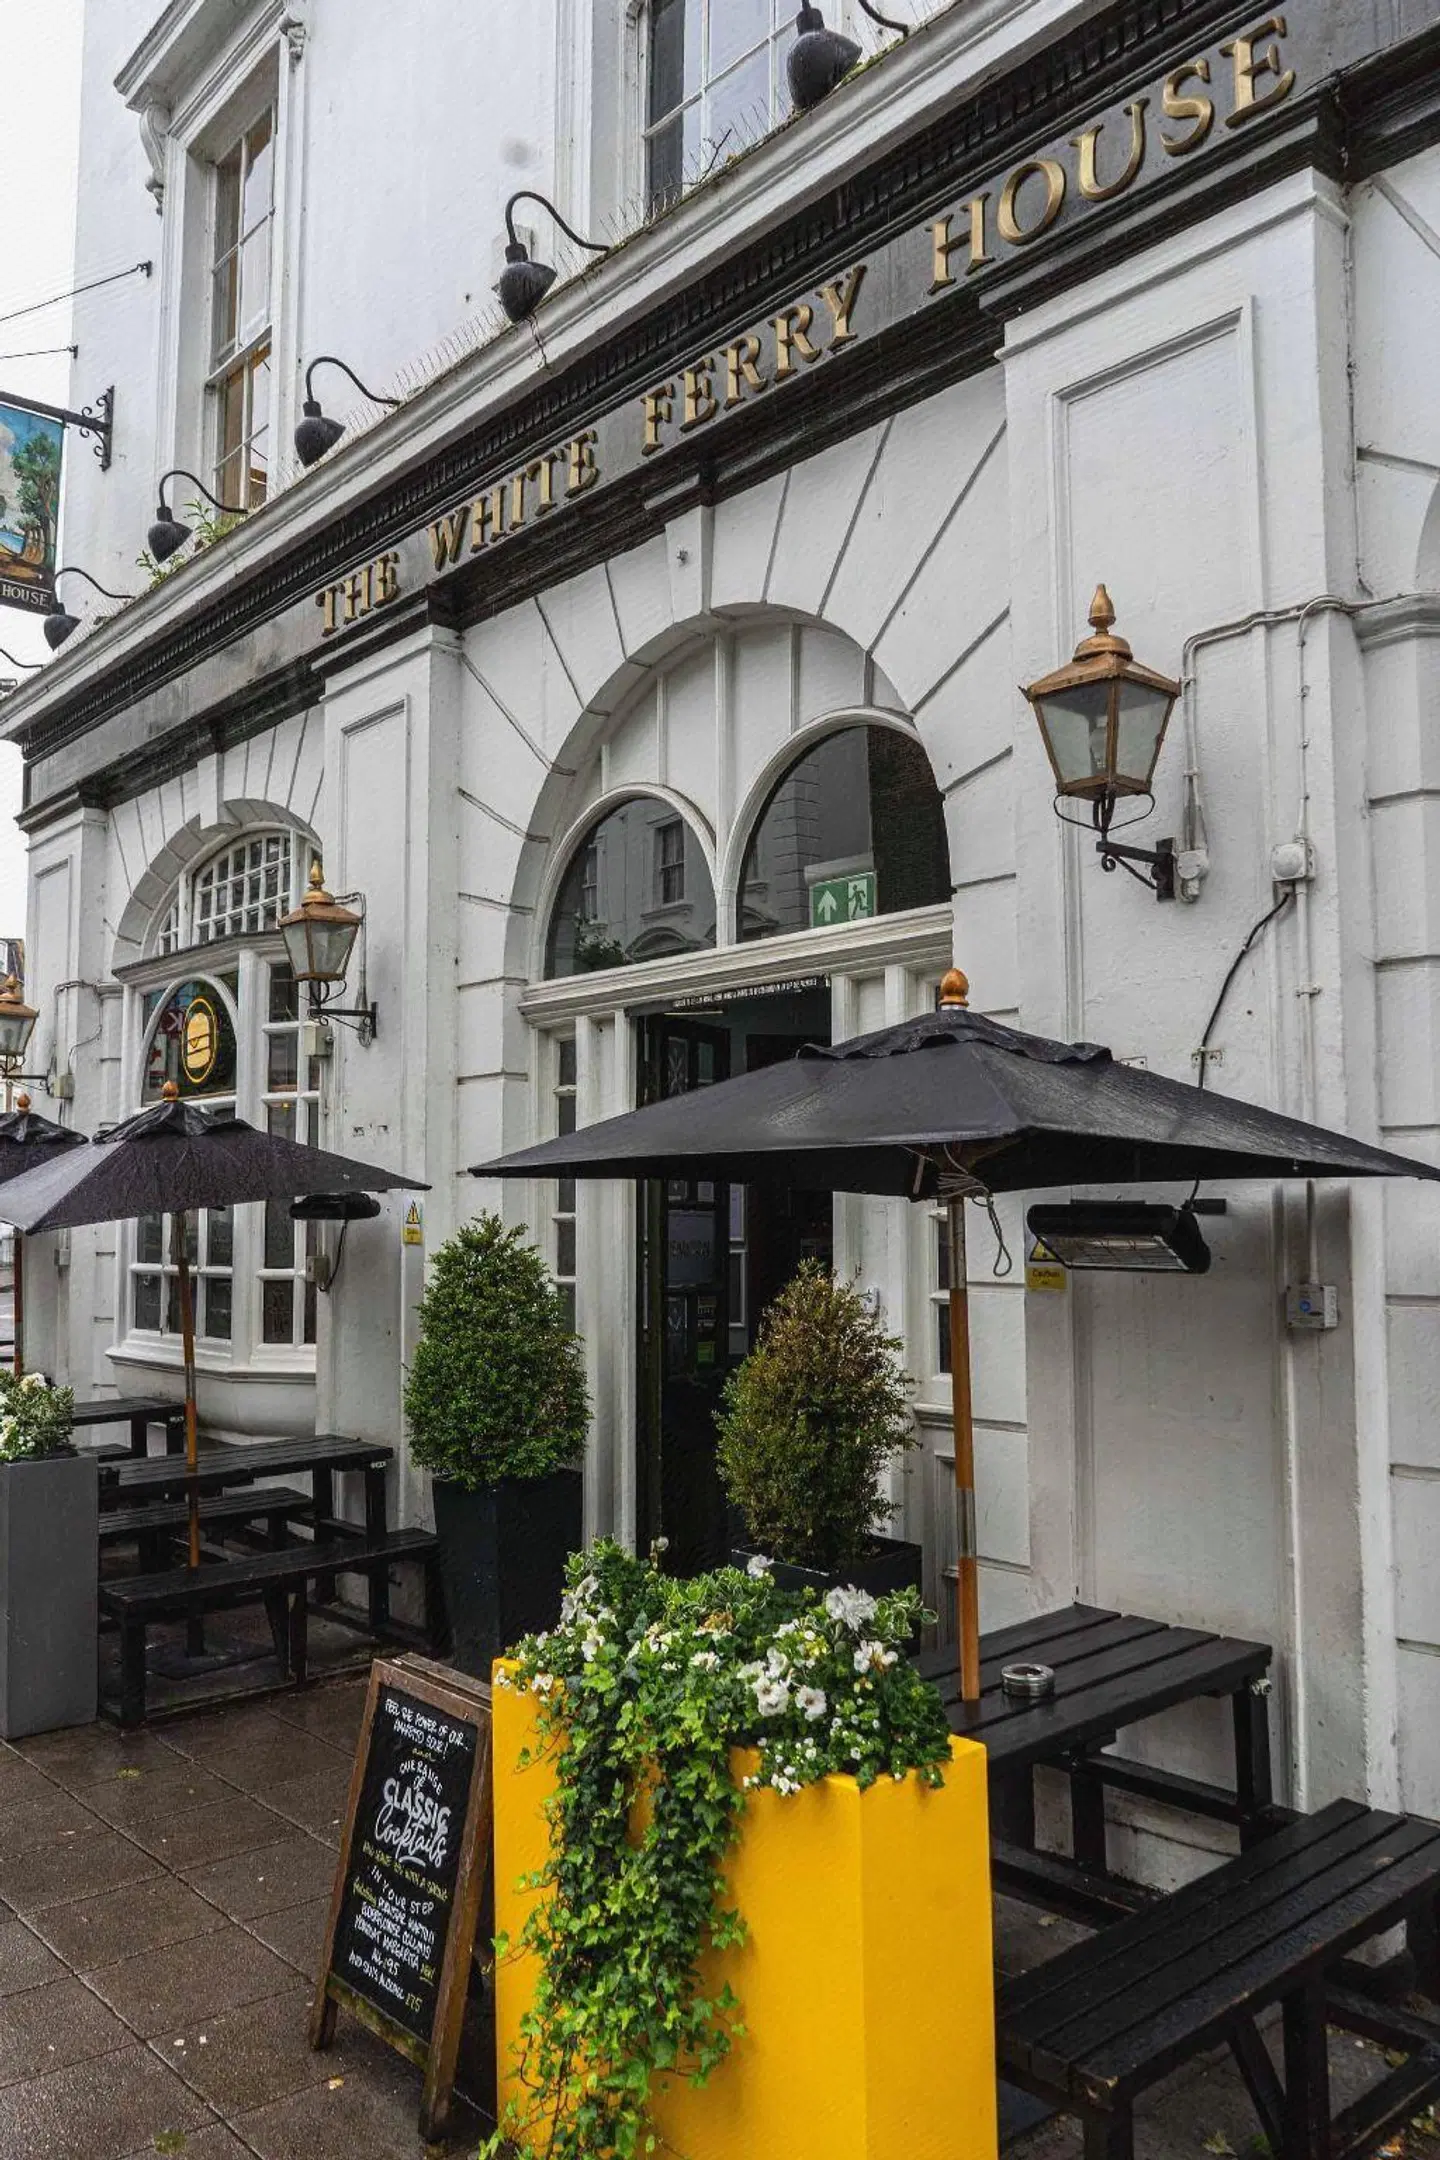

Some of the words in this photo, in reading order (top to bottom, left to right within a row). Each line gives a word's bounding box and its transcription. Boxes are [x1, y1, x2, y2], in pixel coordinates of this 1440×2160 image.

[315, 551, 400, 637] THE
[425, 430, 599, 572] WHITE
[640, 265, 867, 456] FERRY
[925, 15, 1296, 295] HOUSE
[2, 584, 49, 607] HOUSE
[383, 1777, 452, 1834] CLASSIC
[375, 1802, 447, 1869] Cocktails
[371, 1865, 383, 1884] IN
[382, 1879, 406, 1912] YOUR
[410, 1901, 434, 1915] STEP
